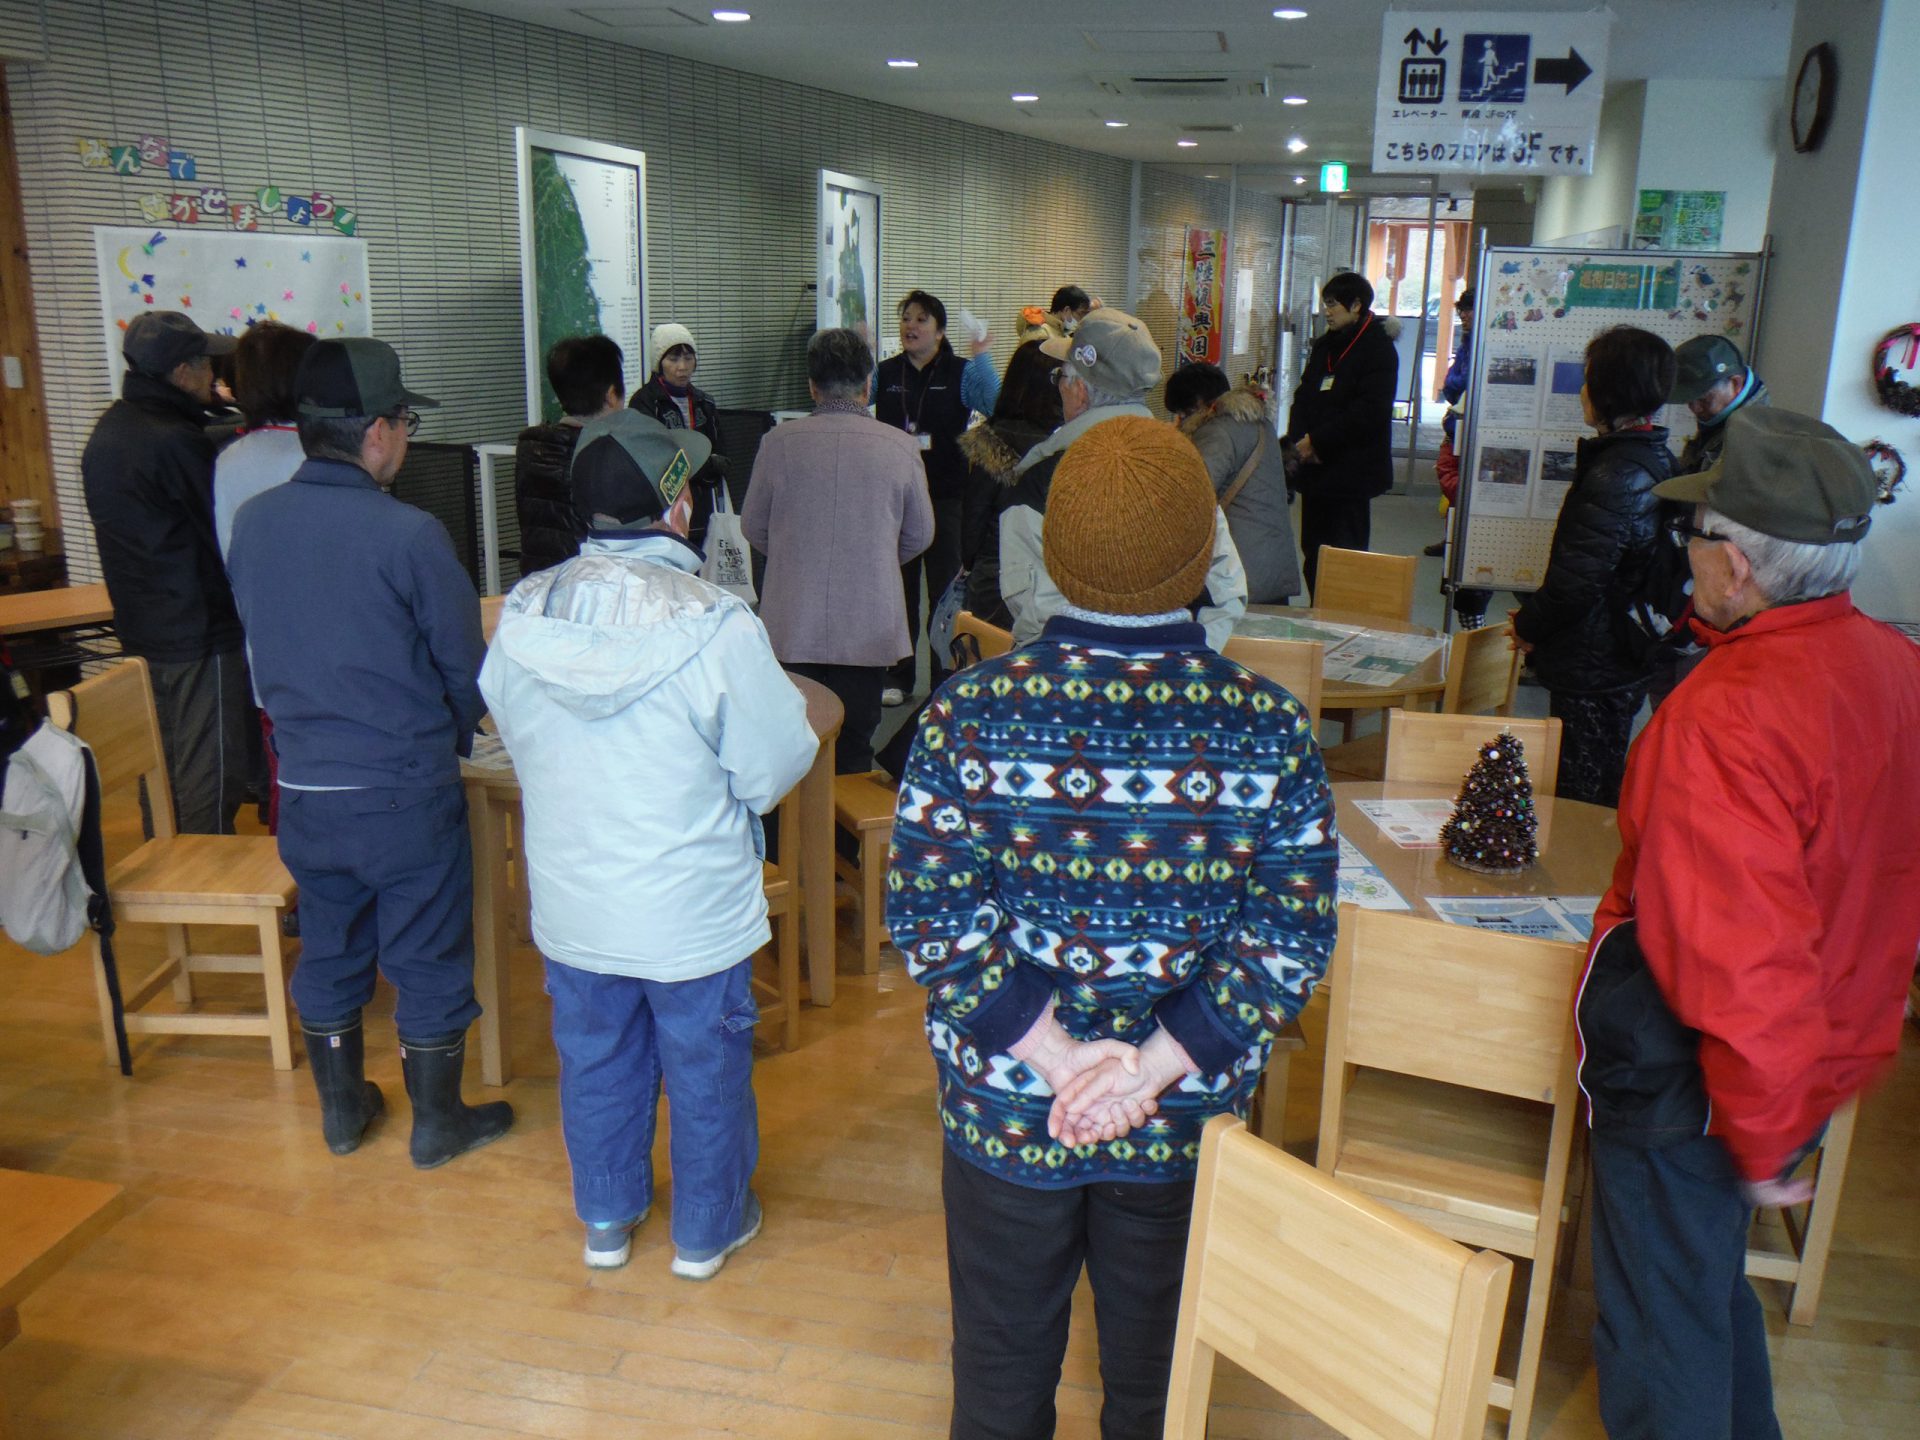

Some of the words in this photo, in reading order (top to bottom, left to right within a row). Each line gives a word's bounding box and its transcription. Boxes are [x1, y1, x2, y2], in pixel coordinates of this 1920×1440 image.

[1392, 109, 1449, 119] エレベーター
[81, 136, 195, 179] みんなで
